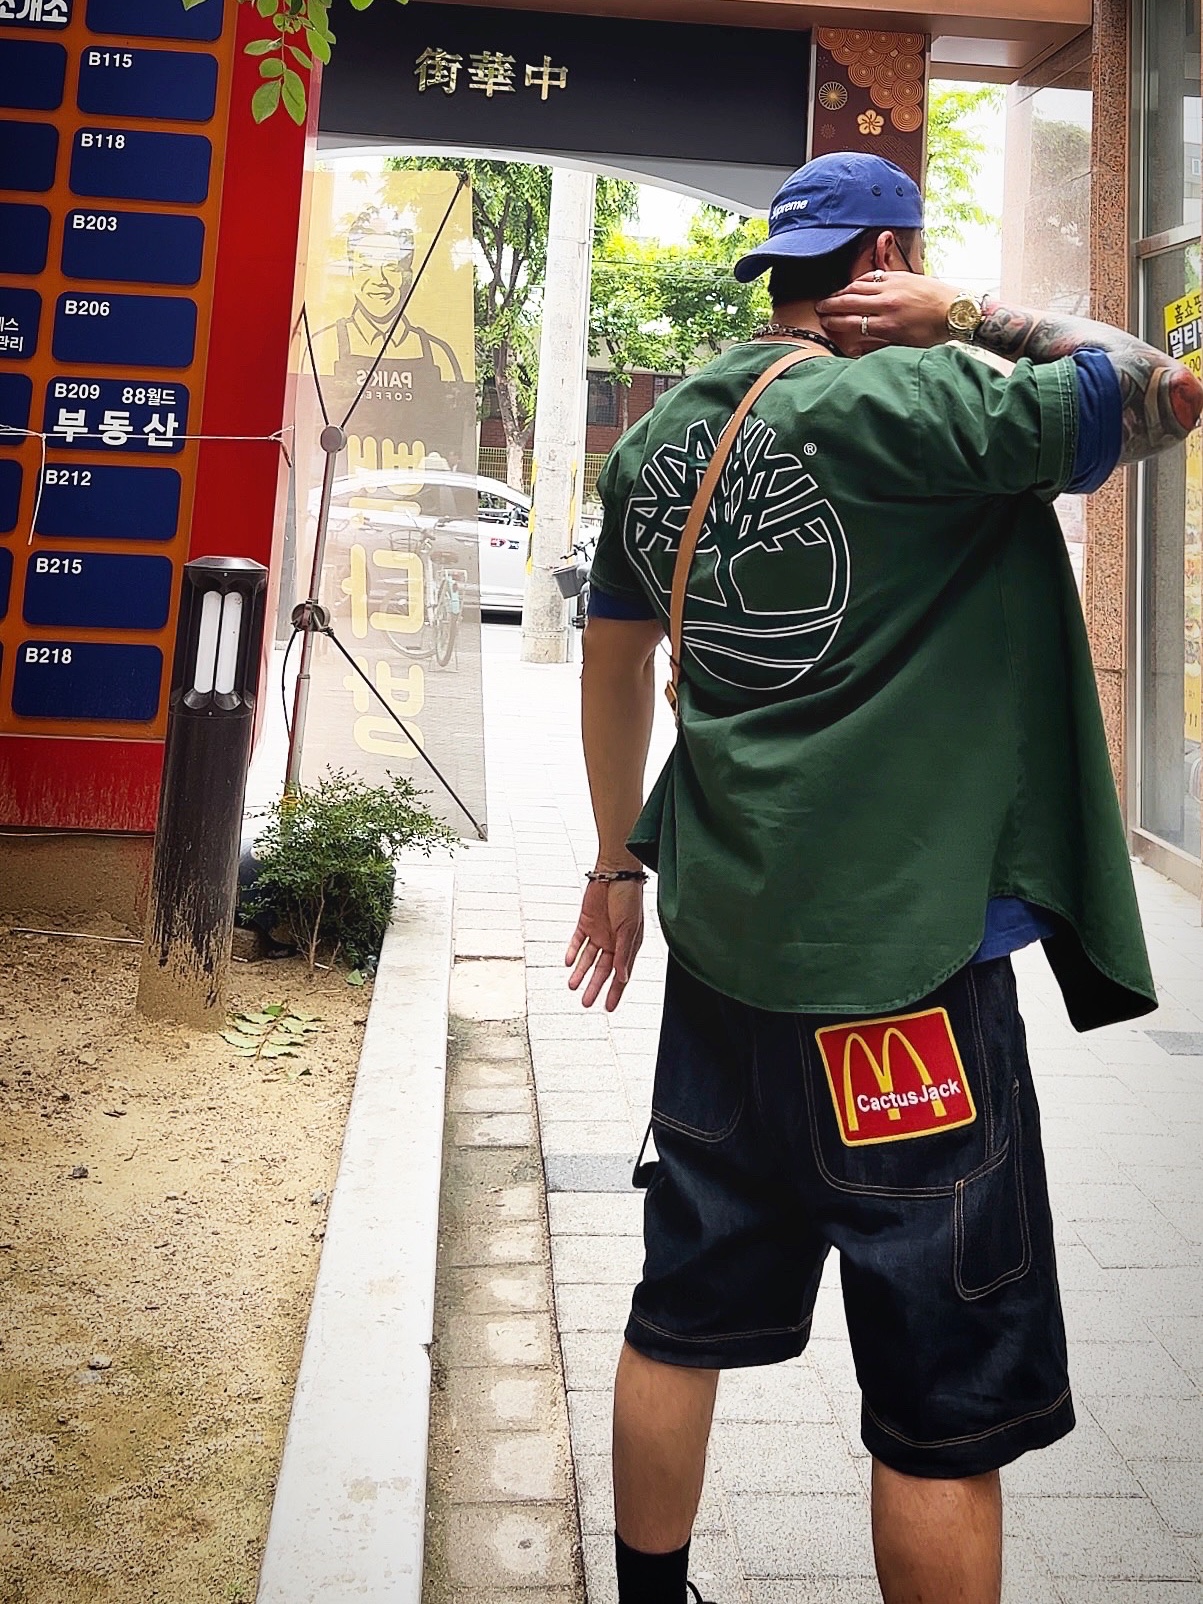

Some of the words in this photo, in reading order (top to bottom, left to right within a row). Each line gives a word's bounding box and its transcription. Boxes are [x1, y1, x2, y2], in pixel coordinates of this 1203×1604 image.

[88, 51, 133, 68] B115
[81, 133, 126, 150] B118
[72, 214, 118, 232] B203
[64, 299, 110, 317] B206
[1170, 319, 1202, 359] 멀티
[54, 382, 100, 400] B209
[121, 387, 177, 406] 88월드
[45, 470, 92, 486] B212
[35, 557, 83, 575] B215
[25, 647, 72, 664] B218
